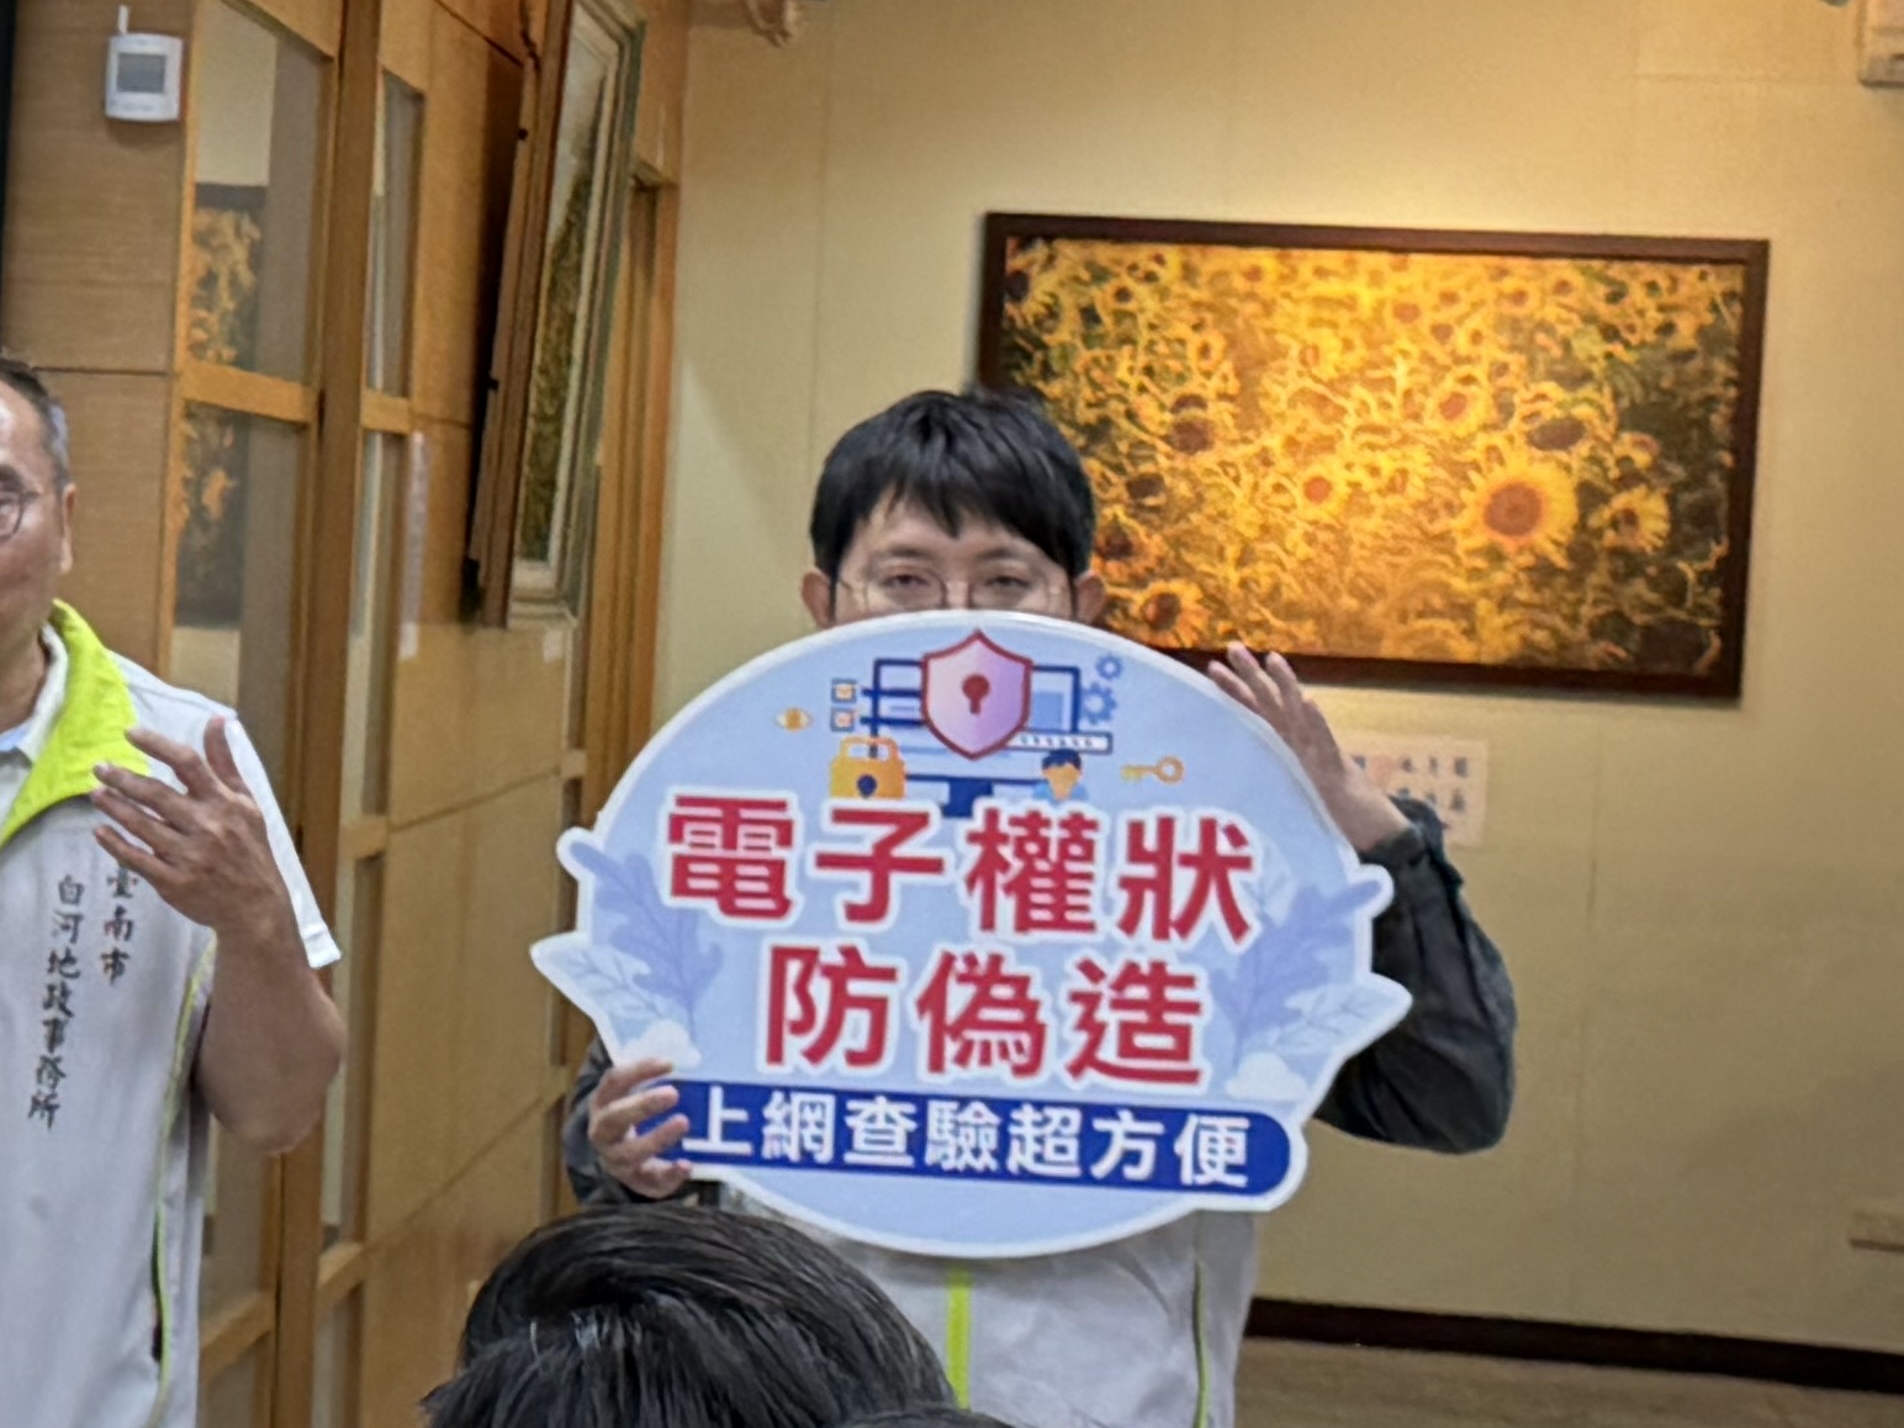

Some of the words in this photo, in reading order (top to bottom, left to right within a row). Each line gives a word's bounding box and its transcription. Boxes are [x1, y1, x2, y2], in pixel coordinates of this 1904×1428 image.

[666, 794, 1254, 946] 電子權狀
[28, 874, 85, 1129] 白河地政事務所
[764, 945, 1204, 1088] 防偽造
[682, 1085, 1250, 1190] 上網查驗超方便
